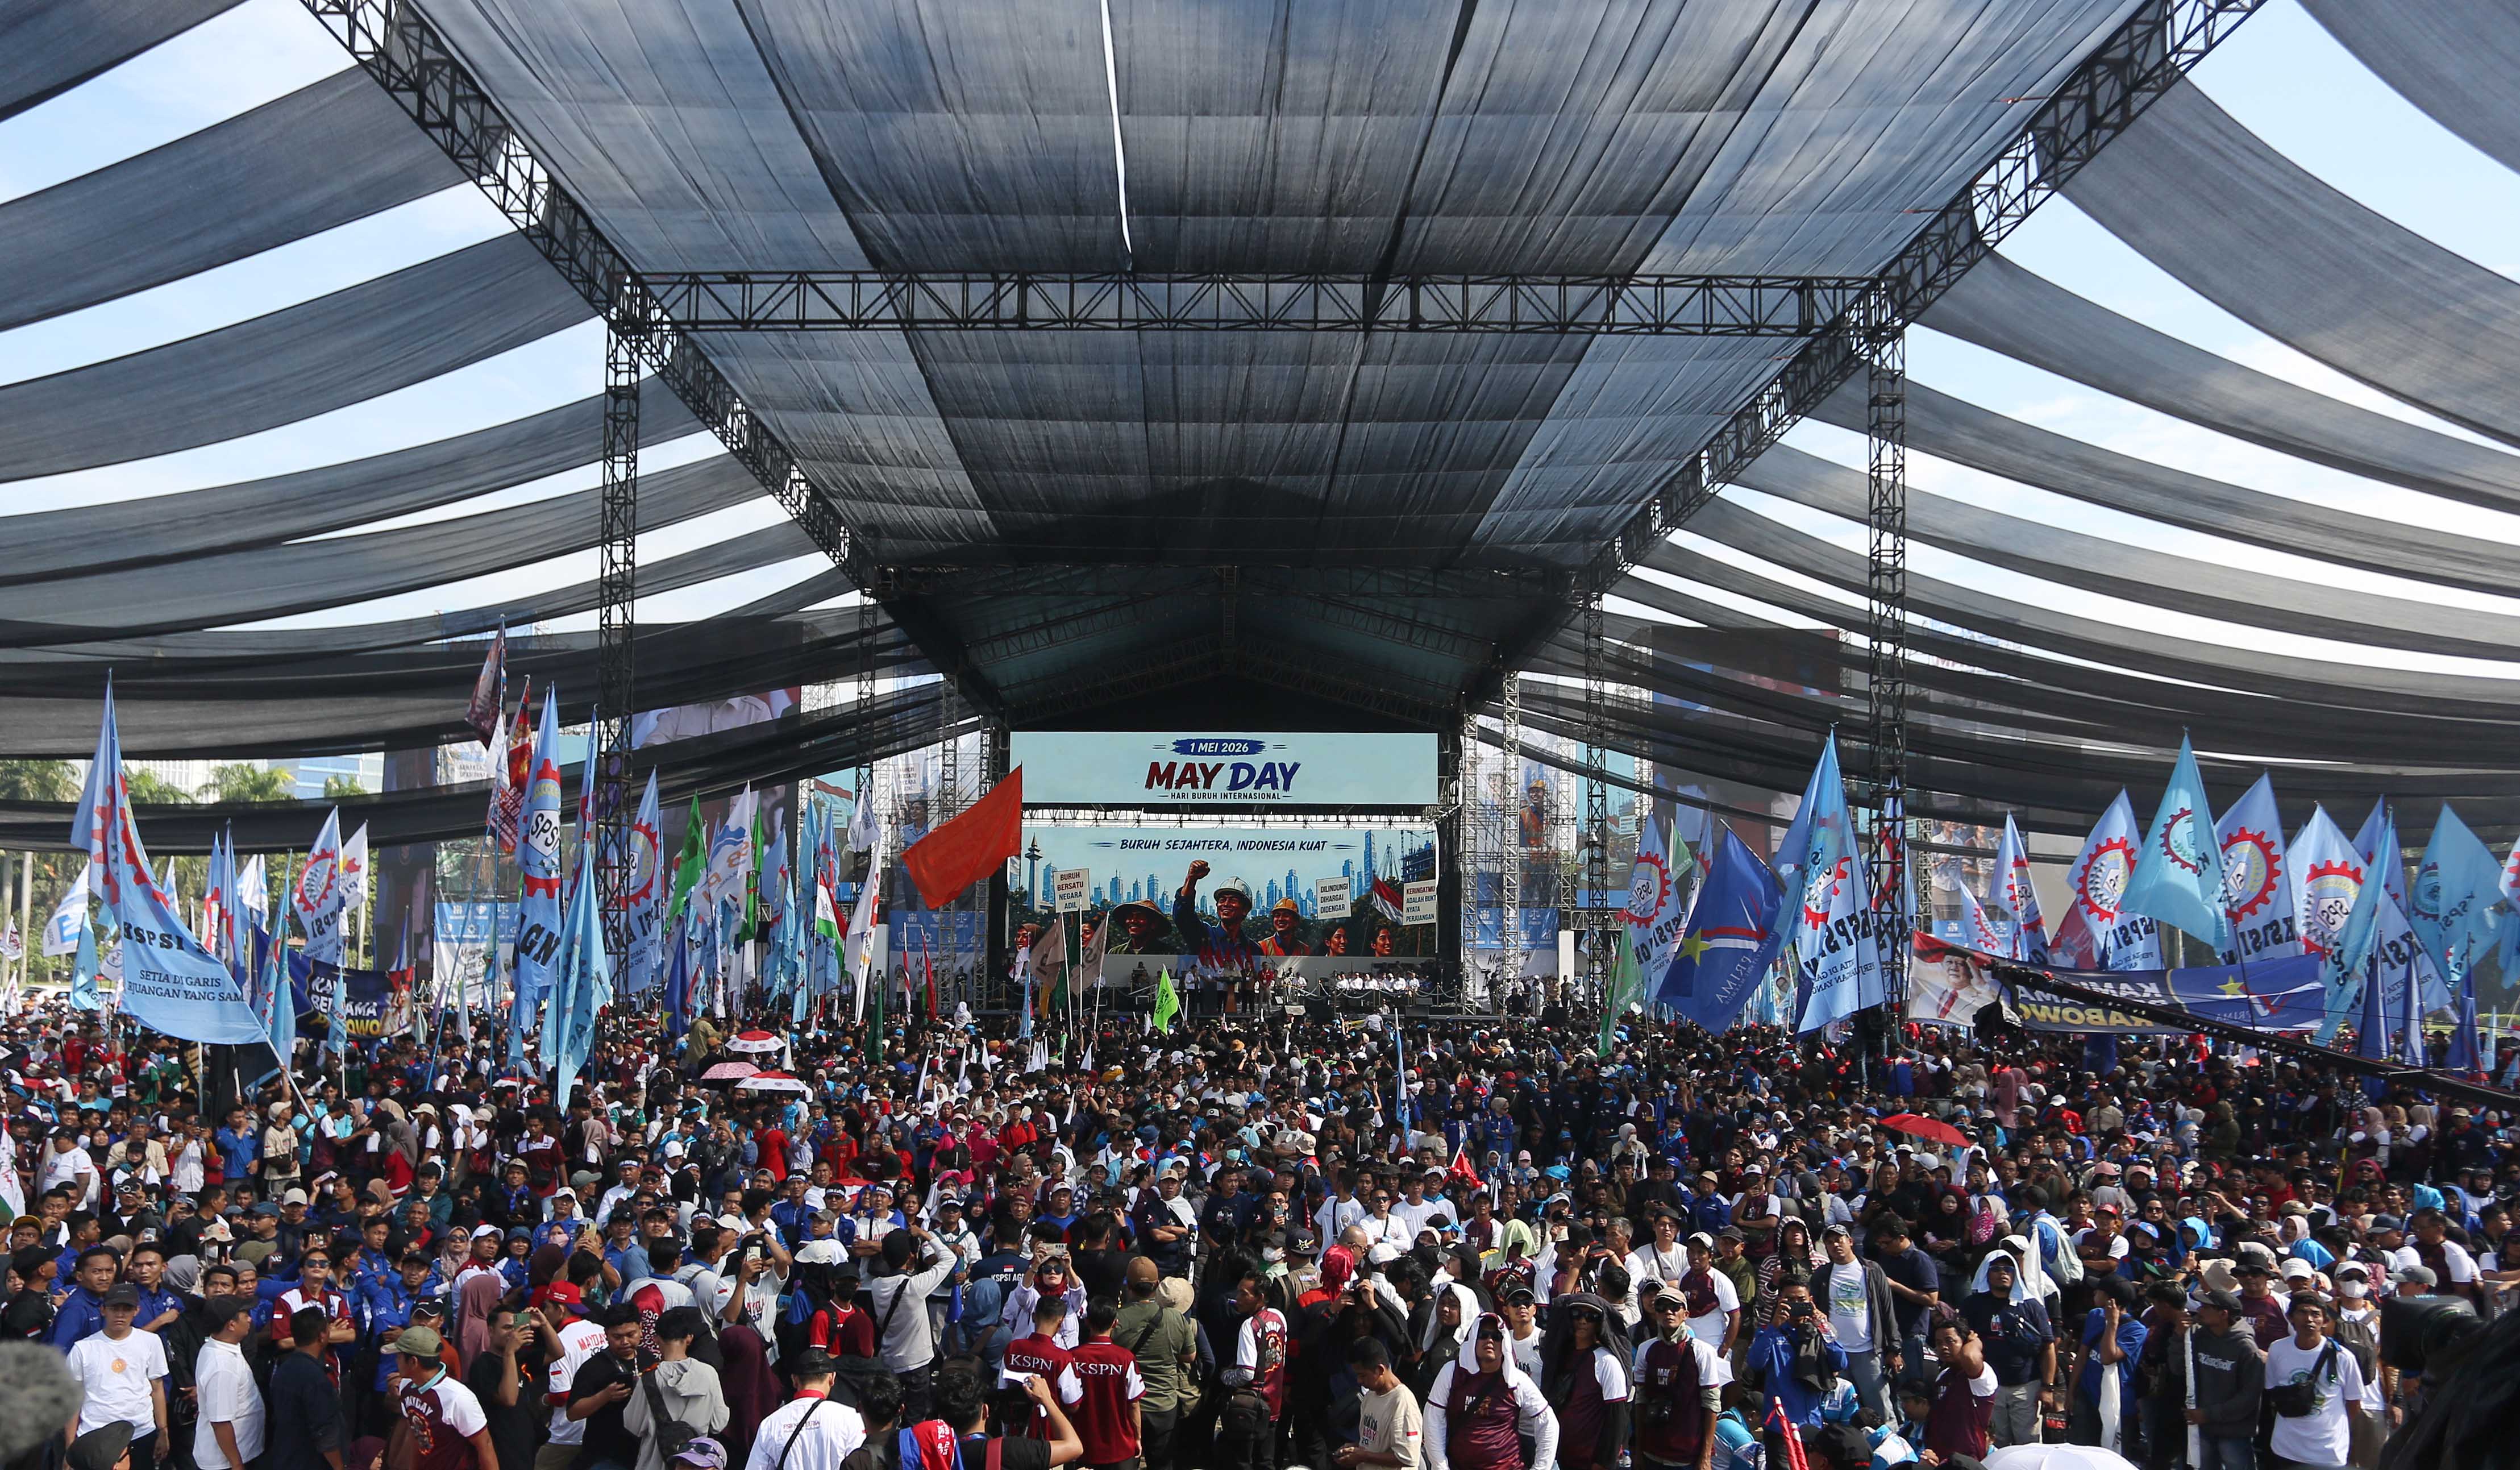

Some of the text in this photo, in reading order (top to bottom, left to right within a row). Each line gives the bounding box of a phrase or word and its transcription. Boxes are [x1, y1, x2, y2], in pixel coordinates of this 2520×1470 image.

[1190, 742, 1249, 753] 1 MEI 2026
[1145, 761, 1301, 792] MAY DAY
[1120, 839, 1328, 852] BURUH SEJAHTERA, INDONESIA KUAT
[1060, 871, 1080, 881] BURUH
[1057, 881, 1083, 891] BERSATU
[1320, 883, 1348, 893] DILINDUNGI
[1406, 886, 1435, 895] KERINGATMU
[1059, 891, 1082, 900] NEGARA
[1320, 894, 1344, 903] DIHARGAI
[1320, 904, 1345, 913] DIDENGAR
[140, 970, 221, 987] SETIA DI GARIS
[181, 990, 215, 1001] YANG
[991, 1274, 1011, 1282] KSPSI
[1010, 1353, 1053, 1371] KSPN
[1075, 1362, 1122, 1376] KSPN
[937, 1425, 945, 1440] TSK
